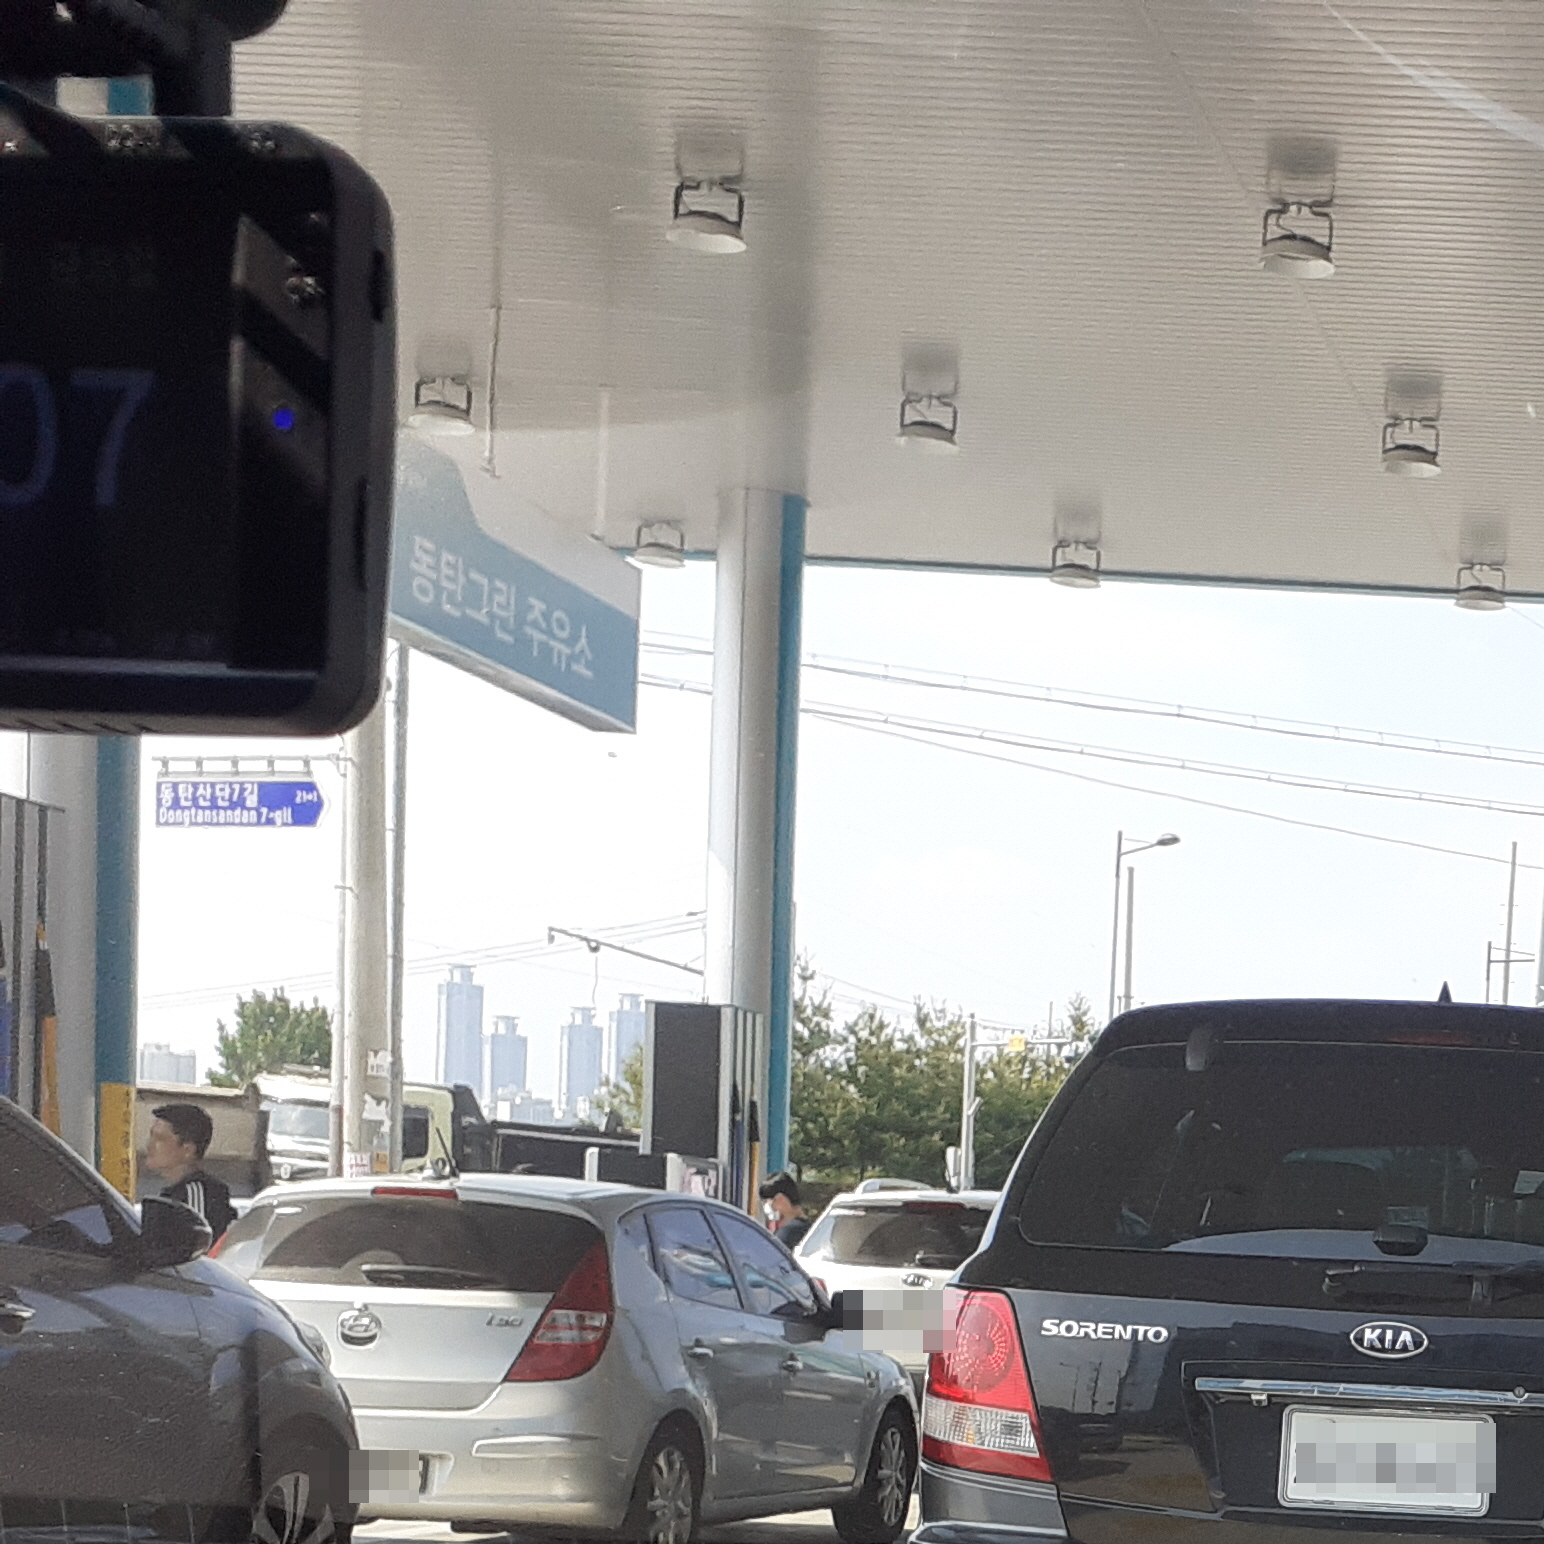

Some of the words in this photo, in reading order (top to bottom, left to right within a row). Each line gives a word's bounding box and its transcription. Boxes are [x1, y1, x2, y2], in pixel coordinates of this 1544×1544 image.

[409, 535, 516, 644] 동탄그린
[523, 596, 594, 680] 주유소
[159, 783, 258, 807] 동탄산단7길
[159, 807, 257, 826] Dongtansandan
[260, 807, 293, 826] 7-gil
[1041, 1319, 1169, 1343] SORENTO
[1363, 1328, 1415, 1351] KIA
